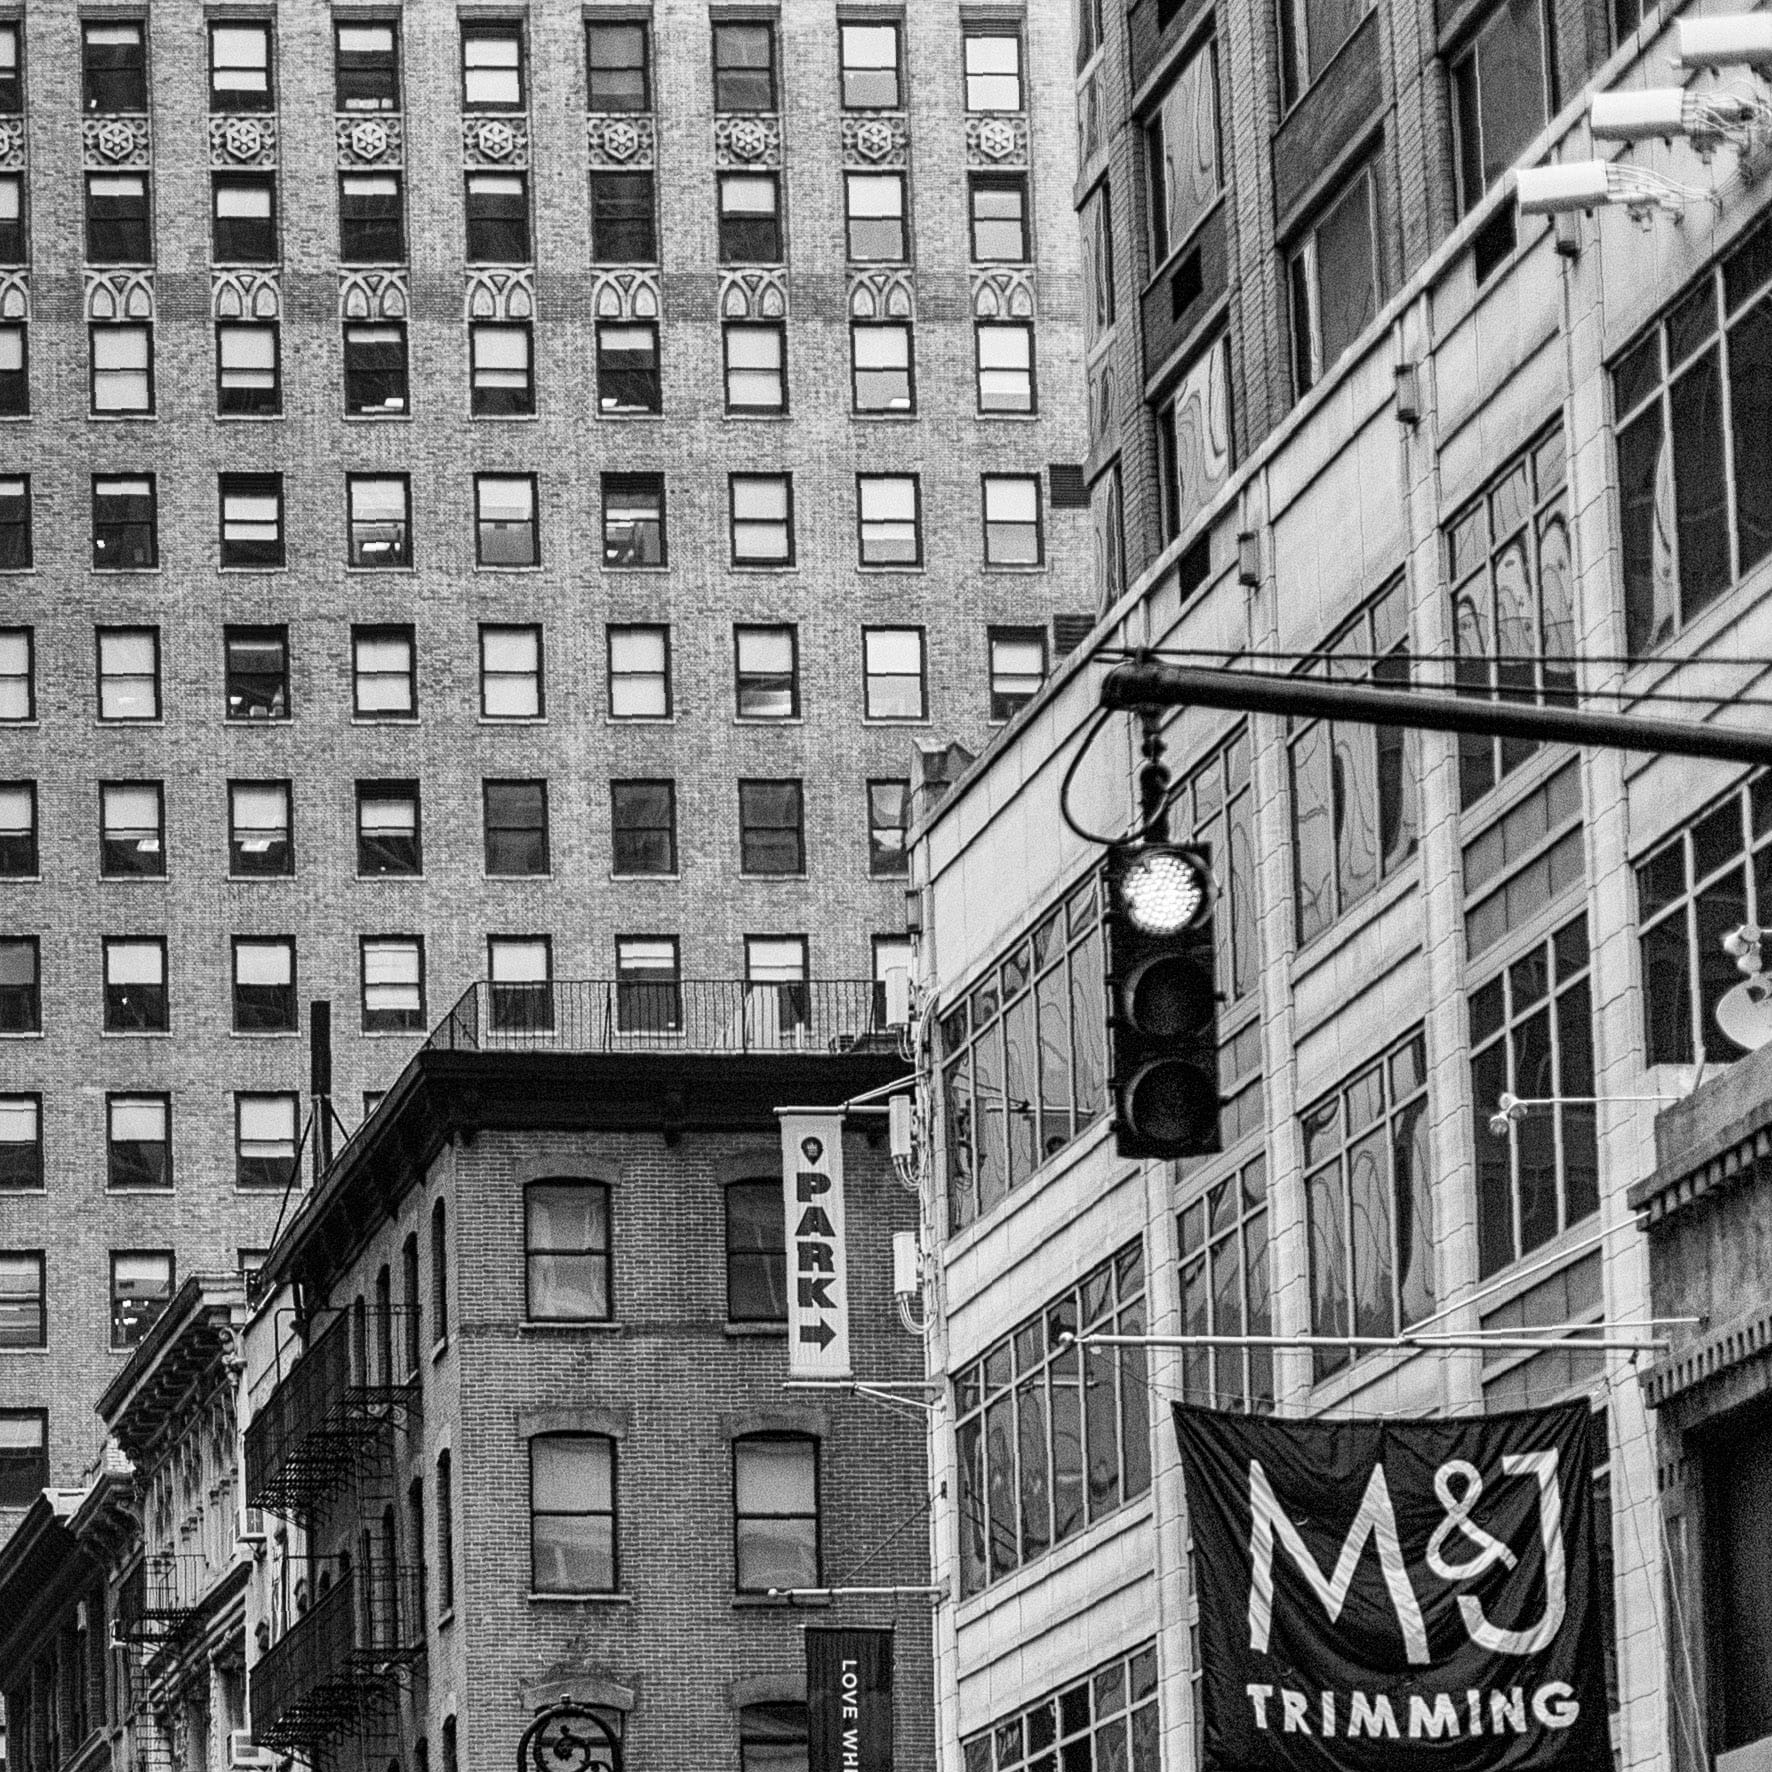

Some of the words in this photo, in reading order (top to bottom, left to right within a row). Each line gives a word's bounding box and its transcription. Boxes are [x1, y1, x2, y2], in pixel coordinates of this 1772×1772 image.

[795, 1172, 838, 1309] PARK
[1249, 1449, 1566, 1664] M&J
[842, 1660, 857, 1719] LOVE
[1247, 1681, 1580, 1738] TRIMMING
